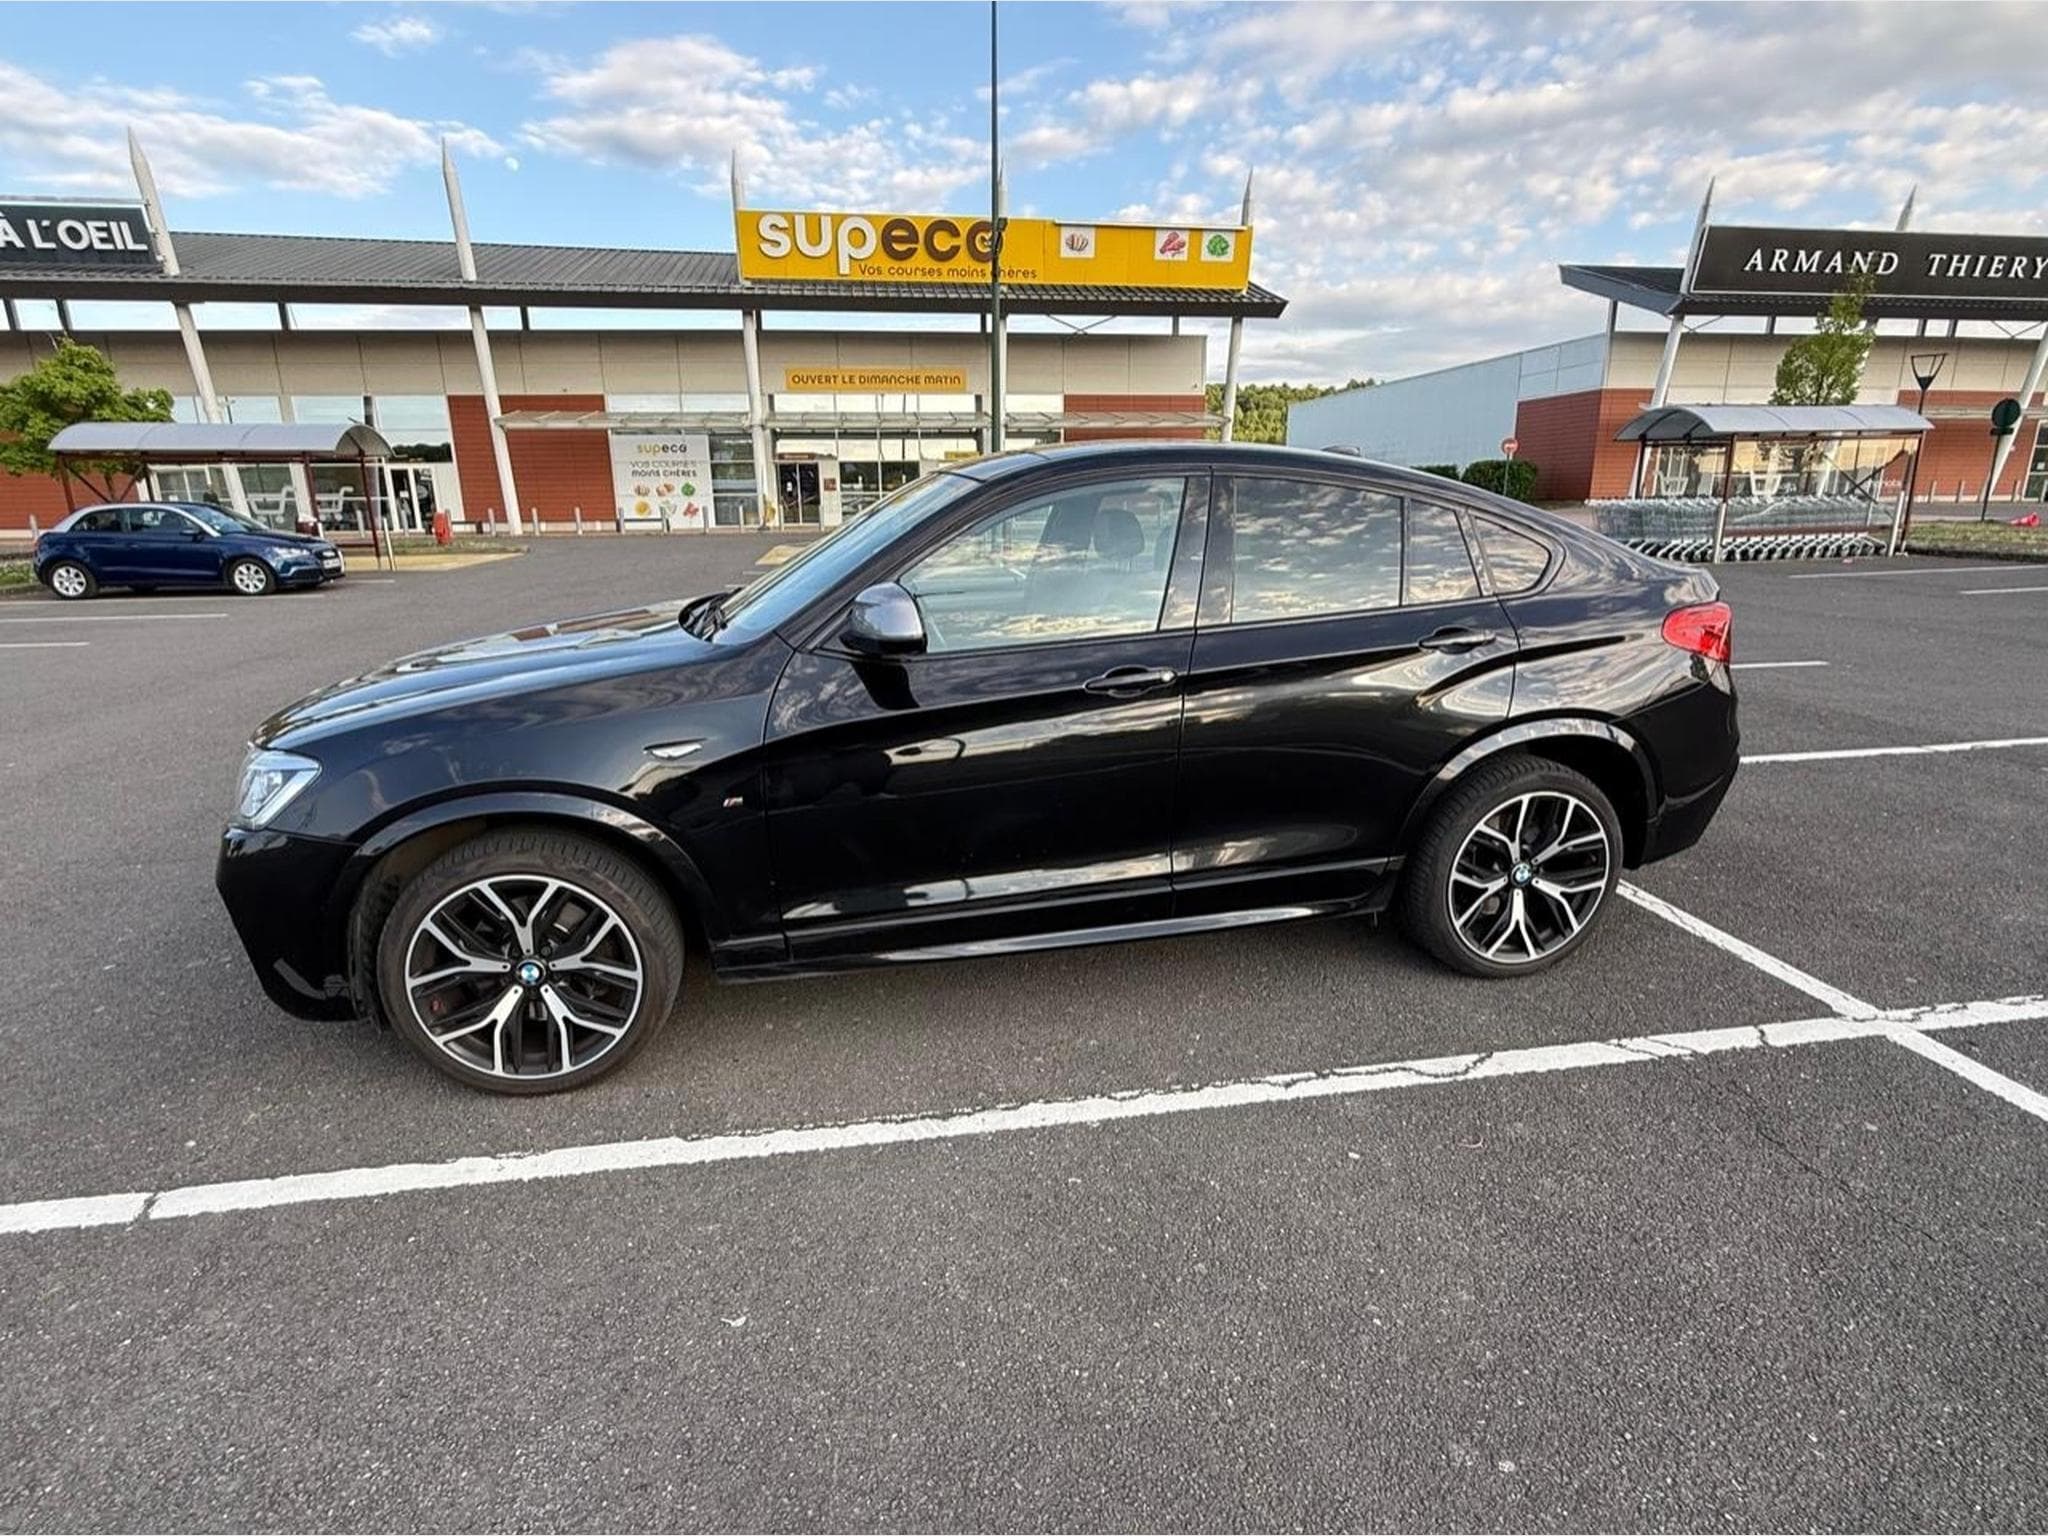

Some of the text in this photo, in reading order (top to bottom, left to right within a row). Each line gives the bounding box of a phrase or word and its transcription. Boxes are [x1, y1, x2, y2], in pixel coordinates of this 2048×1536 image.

[758, 213, 1004, 275] supeco
[1743, 247, 2048, 279] ARMAND THIERY
[858, 264, 883, 276] Vos
[887, 266, 943, 278] courses
[947, 266, 987, 279] moins
[791, 374, 961, 385] OUVERT LE DIMANCHE MATIN
[637, 444, 687, 456] supeco
